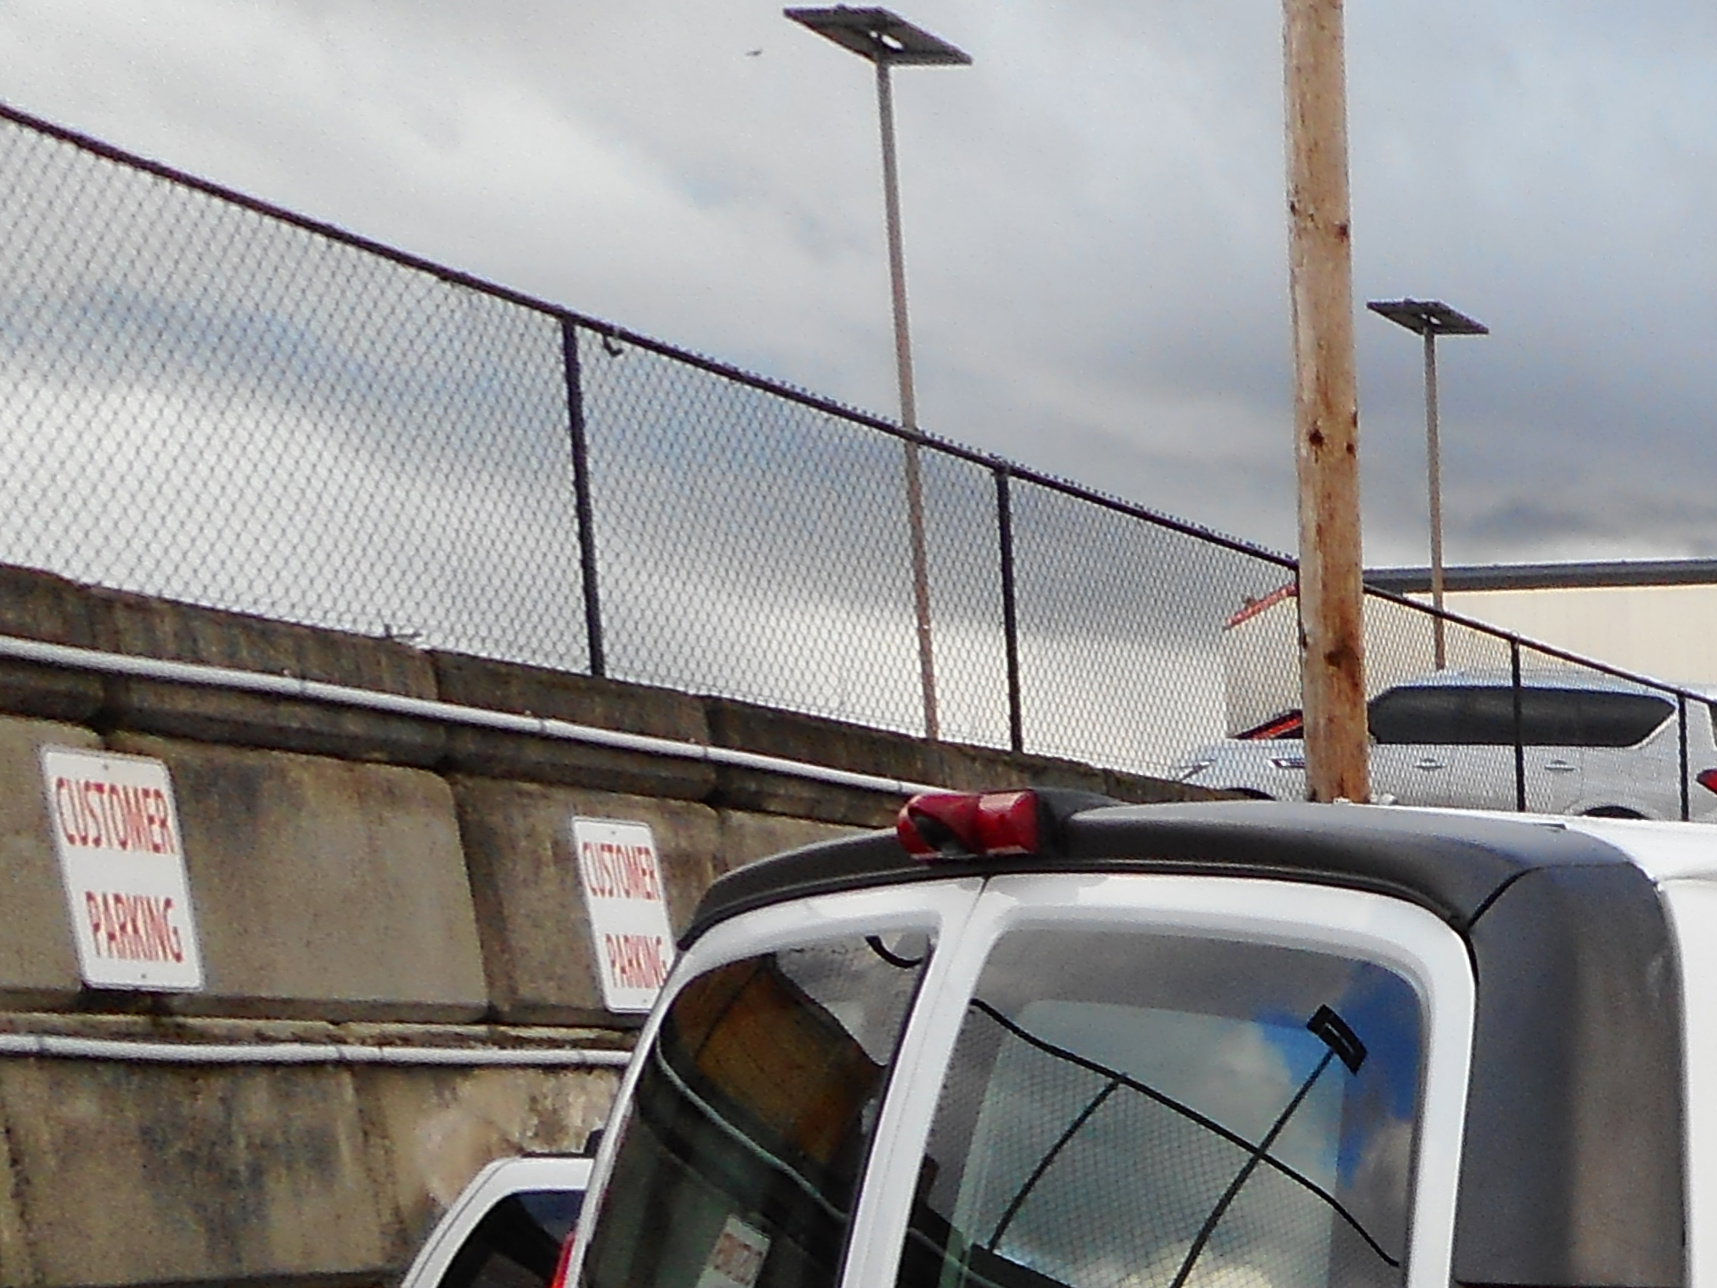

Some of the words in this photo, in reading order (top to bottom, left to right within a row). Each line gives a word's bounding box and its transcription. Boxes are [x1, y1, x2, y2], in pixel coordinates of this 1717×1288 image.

[57, 777, 176, 855] CUSTOMER
[583, 841, 663, 901] CUSTOMER
[85, 890, 183, 963] PARKING
[605, 933, 668, 989] PARKING
